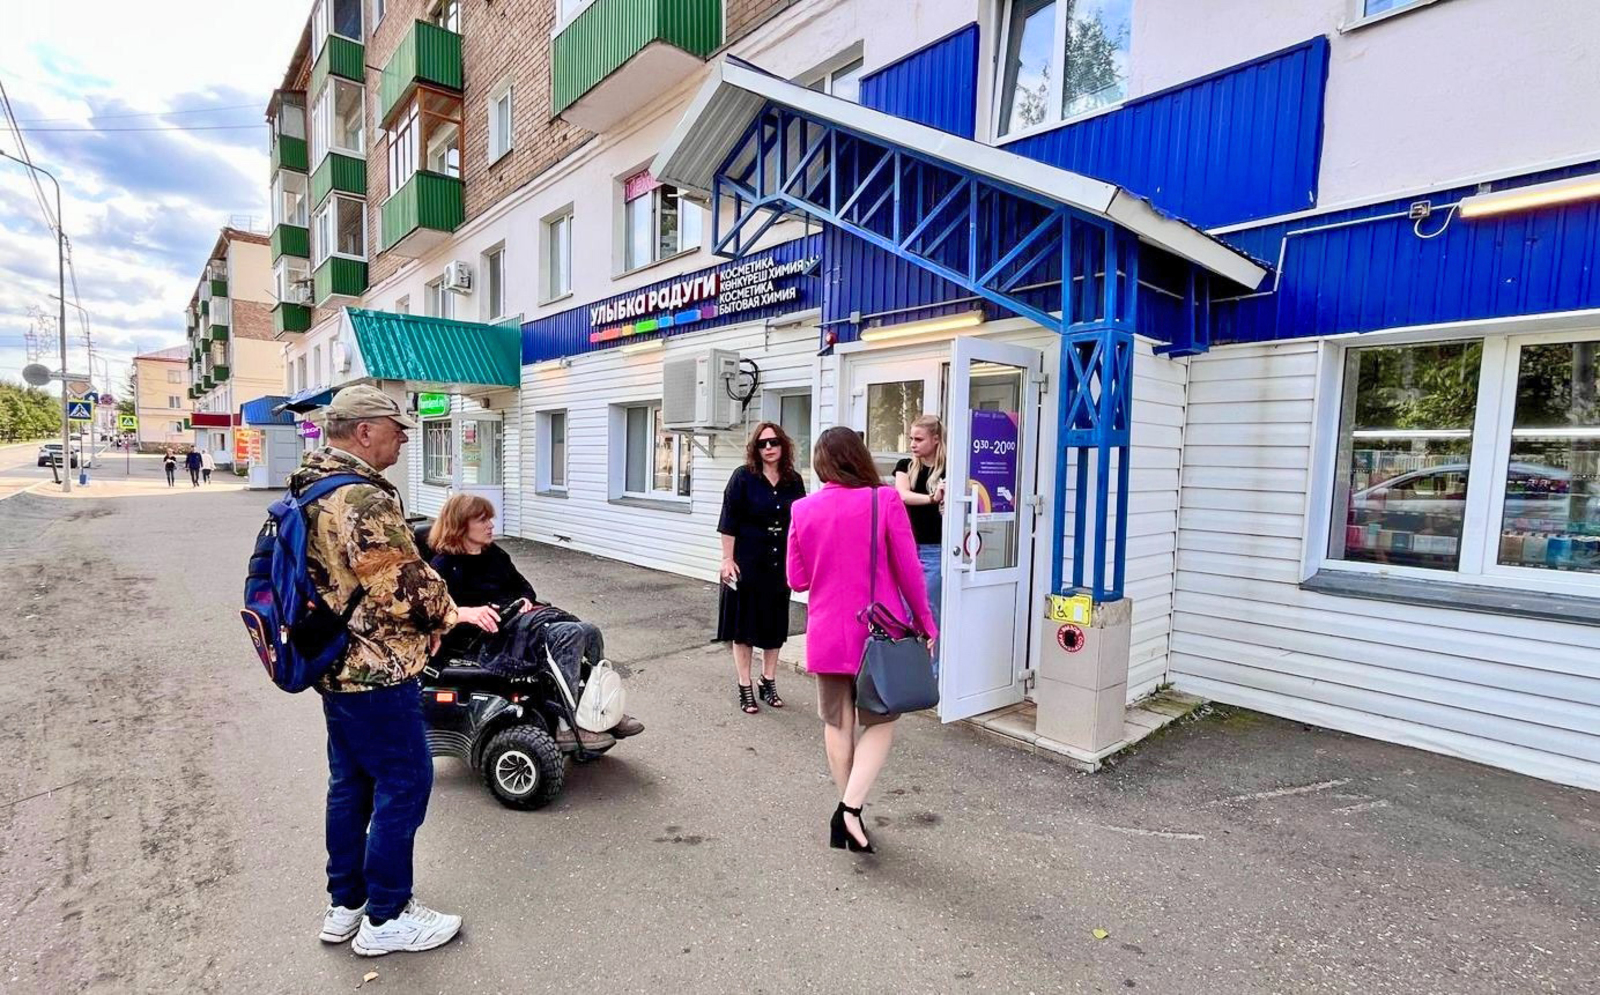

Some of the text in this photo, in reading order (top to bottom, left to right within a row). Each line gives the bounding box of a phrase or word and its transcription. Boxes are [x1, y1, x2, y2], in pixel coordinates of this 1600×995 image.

[720, 256, 774, 281] КОСМЕТИКА
[719, 280, 774, 304] КОСМЕТИКА
[719, 286, 797, 315] БЫТОВАЯ ХИМИЯ
